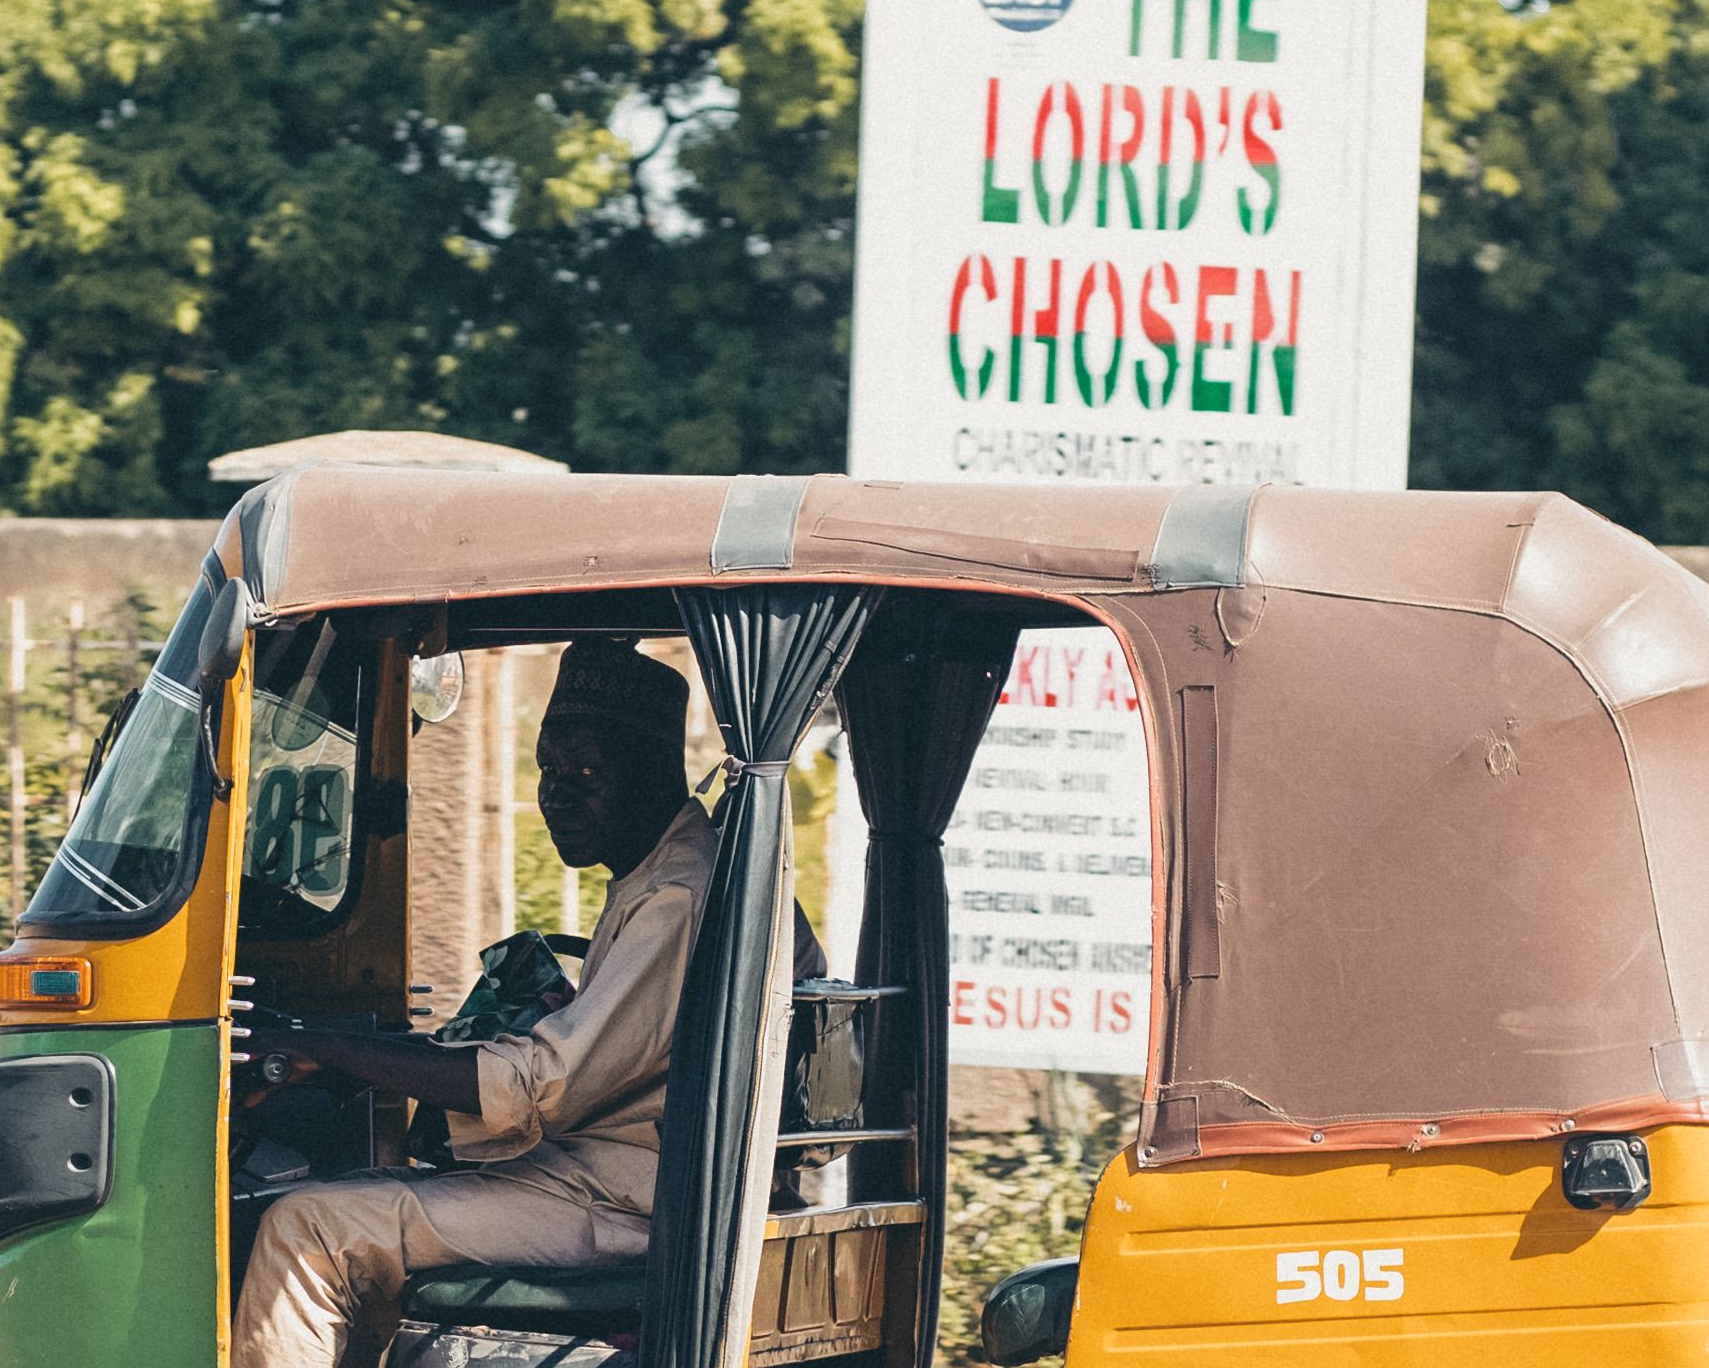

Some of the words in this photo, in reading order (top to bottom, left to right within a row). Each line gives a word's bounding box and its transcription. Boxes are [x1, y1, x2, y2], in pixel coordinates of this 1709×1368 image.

[981, 76, 1284, 237] LORD'S
[947, 253, 1303, 417] CHOSEN
[952, 426, 1165, 483] CHARISMATIC
[999, 645, 1085, 709] KLY
[952, 980, 1073, 1031] ESUS
[1093, 988, 1133, 1035] IS
[1275, 1248, 1405, 1305] 505
